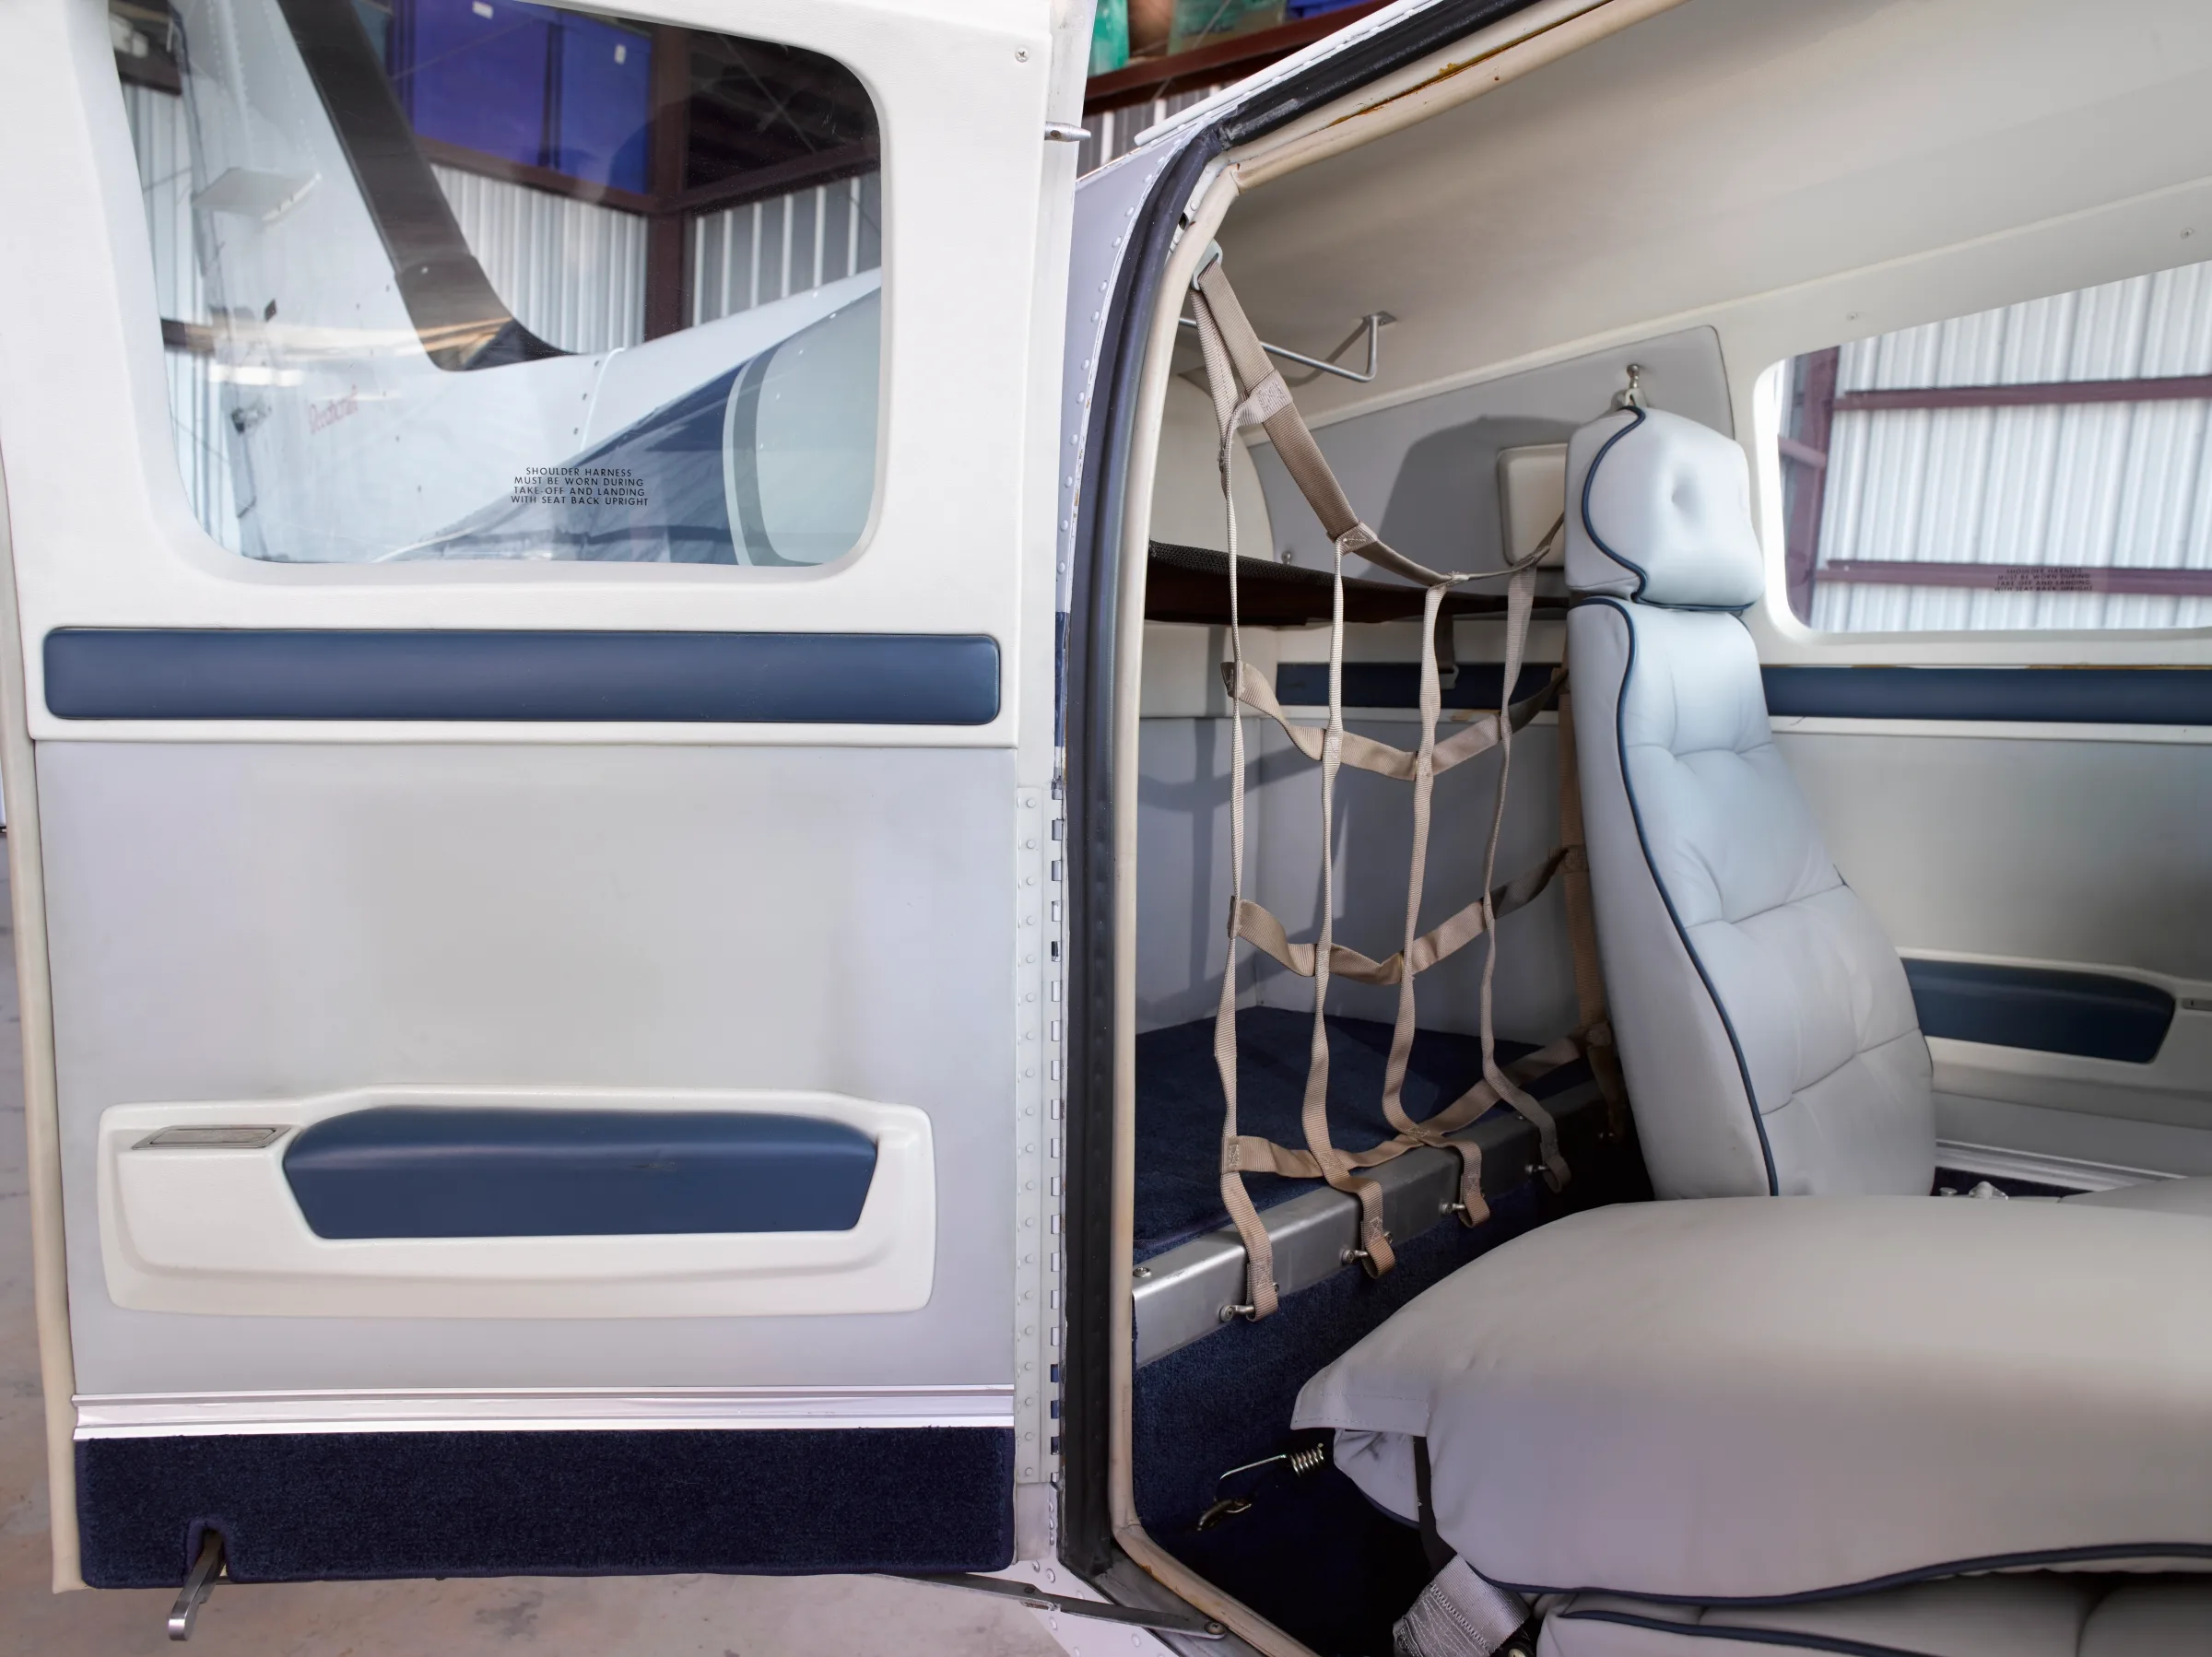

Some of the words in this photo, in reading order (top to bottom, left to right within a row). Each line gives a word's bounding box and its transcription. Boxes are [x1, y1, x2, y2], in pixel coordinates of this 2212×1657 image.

[525, 467, 580, 476] SHOULDER
[584, 468, 632, 477] HARNESS
[514, 476, 543, 485] MUST
[547, 476, 559, 485] BE
[564, 477, 598, 486] WORN
[604, 478, 644, 487] DURING
[513, 486, 564, 495] TAKE-OFF
[569, 487, 593, 496] AND
[597, 488, 645, 497] LANDING
[511, 495, 536, 503] WITH
[542, 496, 567, 504] SEAT
[571, 496, 600, 505] BACK
[605, 498, 649, 506] UPRIGHT
